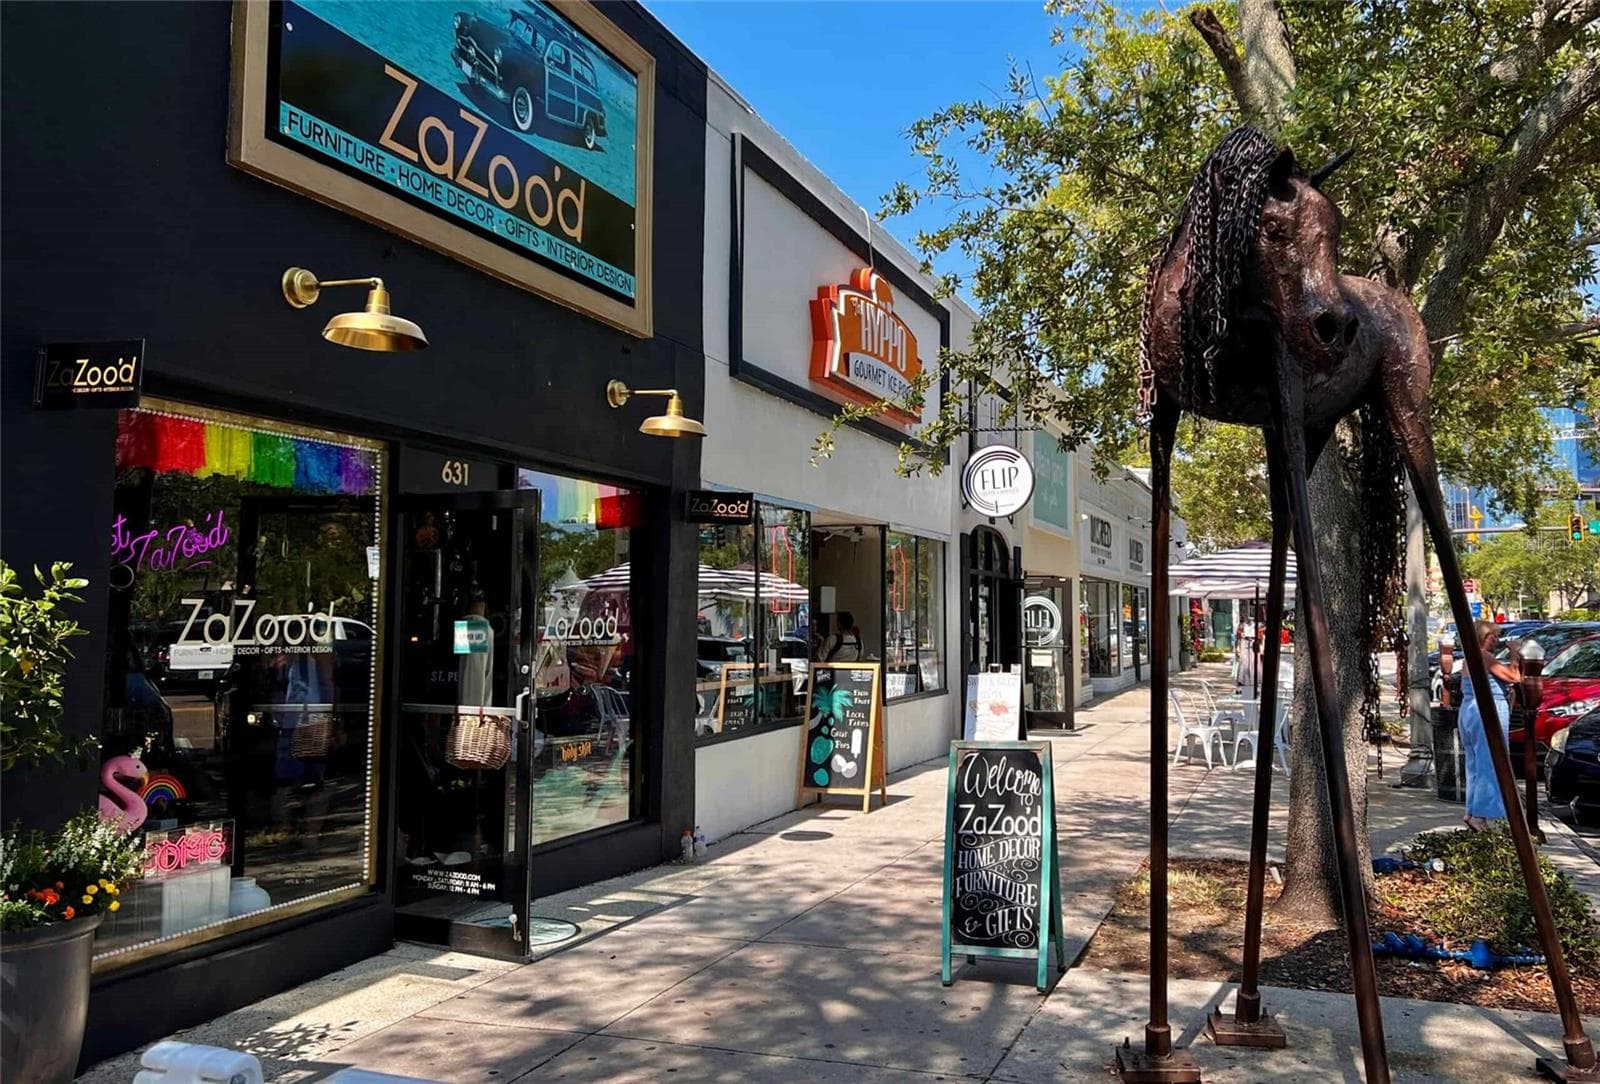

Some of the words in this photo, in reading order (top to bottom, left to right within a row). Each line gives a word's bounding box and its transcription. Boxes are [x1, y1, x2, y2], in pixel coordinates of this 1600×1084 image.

[378, 64, 586, 244] ZaZoo'd
[288, 110, 386, 176] FURNITURE
[398, 166, 443, 203] HOME
[447, 189, 495, 225] DECOR
[505, 217, 540, 248] GIFTS
[546, 236, 595, 274] INTERIOR
[597, 262, 632, 292] DESIGN
[860, 300, 906, 372] HYPPO
[47, 355, 137, 386] ZaZoo'd
[853, 359, 887, 388] GOURMET
[887, 373, 898, 393] ICE
[441, 461, 470, 486] 631
[981, 466, 1019, 490] FLIP
[690, 498, 750, 514] ZaZoo'd
[176, 598, 335, 646] ZaZoo'd
[541, 607, 620, 640] ZaZoo'd
[963, 752, 1042, 798] Welcome
[957, 803, 1042, 836] ZaZoo'd
[957, 847, 996, 871] HOME
[998, 835, 1041, 861] DECOR
[956, 870, 1037, 908] FURNITURE
[985, 905, 1034, 938] GIFTS
